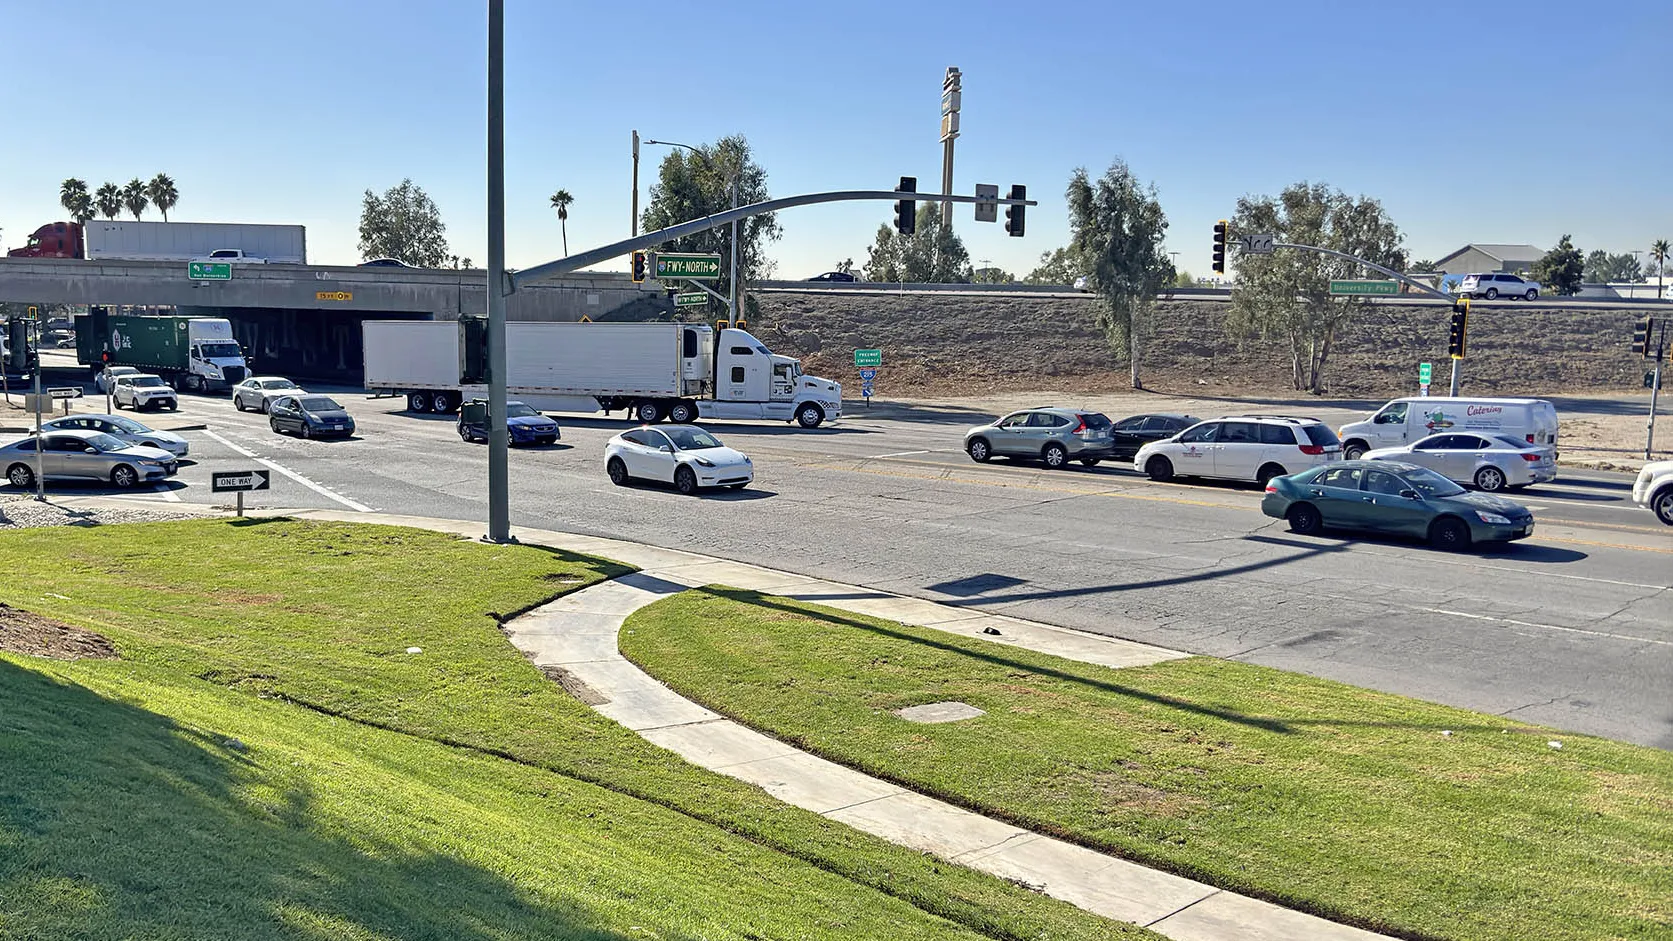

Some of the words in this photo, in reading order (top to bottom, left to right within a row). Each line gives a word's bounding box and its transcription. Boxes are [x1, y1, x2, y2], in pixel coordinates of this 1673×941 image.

[666, 261, 708, 273] FWY-NORTH
[1467, 405, 1503, 417] Catering
[220, 478, 236, 486] ONE
[238, 477, 252, 485] WAY
